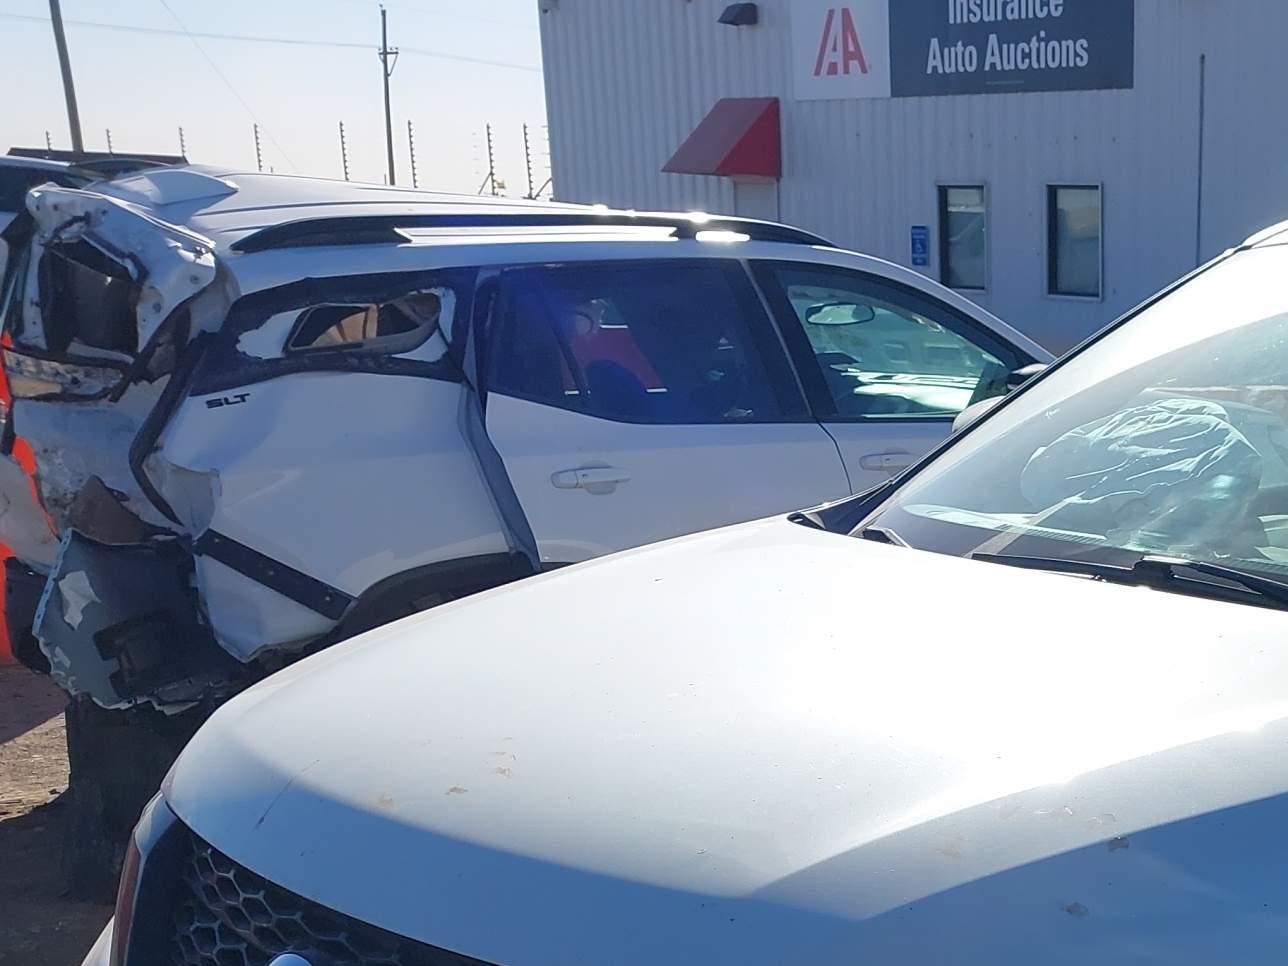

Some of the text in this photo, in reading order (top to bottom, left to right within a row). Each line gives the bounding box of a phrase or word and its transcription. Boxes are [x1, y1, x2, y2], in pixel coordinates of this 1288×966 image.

[949, 0, 1064, 24] Insurance
[926, 30, 1089, 74] Auto Auctions
[206, 393, 251, 409] SLT
